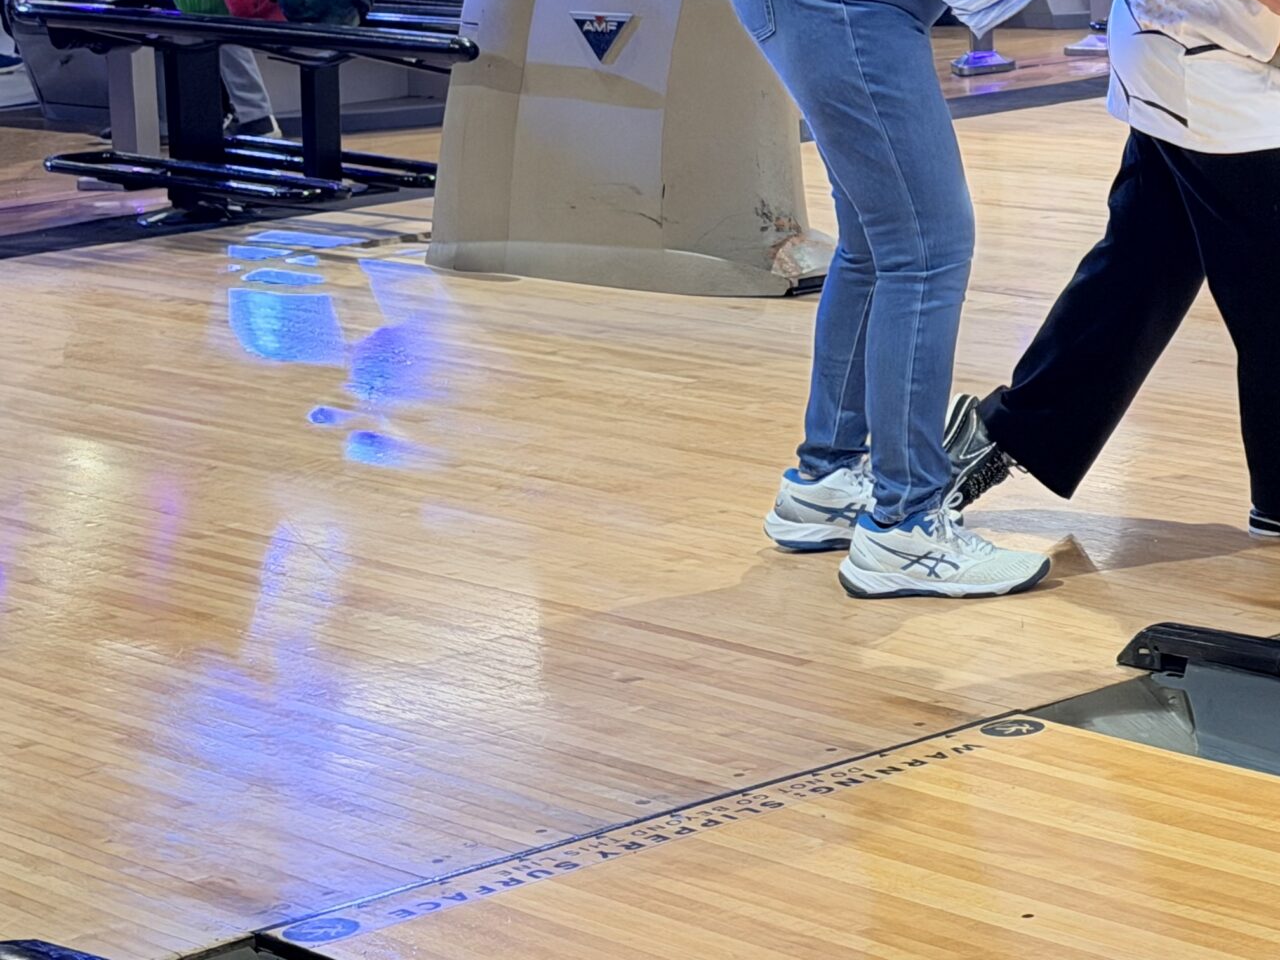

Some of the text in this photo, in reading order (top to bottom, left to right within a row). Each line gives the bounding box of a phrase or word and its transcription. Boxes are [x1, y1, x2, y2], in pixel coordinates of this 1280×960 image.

[582, 20, 618, 33] AMF
[497, 766, 864, 876] DO NOT GO BEYOND THIS LINE
[598, 799, 785, 860] SLIPPERY
[388, 860, 580, 918] SURFACE
